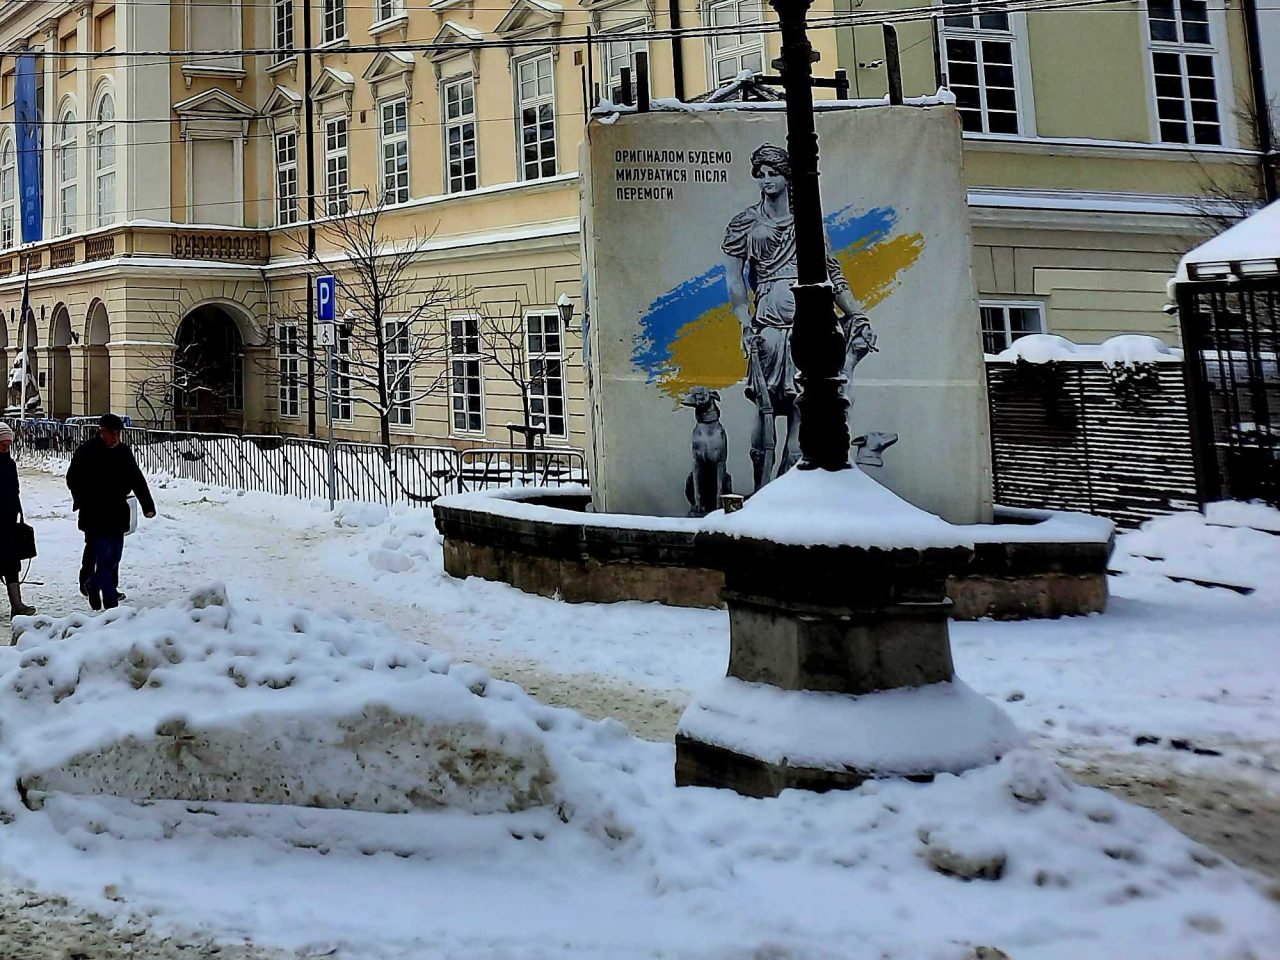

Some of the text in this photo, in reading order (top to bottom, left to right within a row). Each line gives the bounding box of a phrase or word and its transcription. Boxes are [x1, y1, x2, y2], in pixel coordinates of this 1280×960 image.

[615, 150, 732, 165] ОРИГІНАЛОМ БУДЕМО
[616, 168, 727, 182] МИЛУВАТИСЯ ПІСЛЯ
[616, 187, 673, 200] ПЕРЕМОГИ
[320, 282, 330, 316] P
